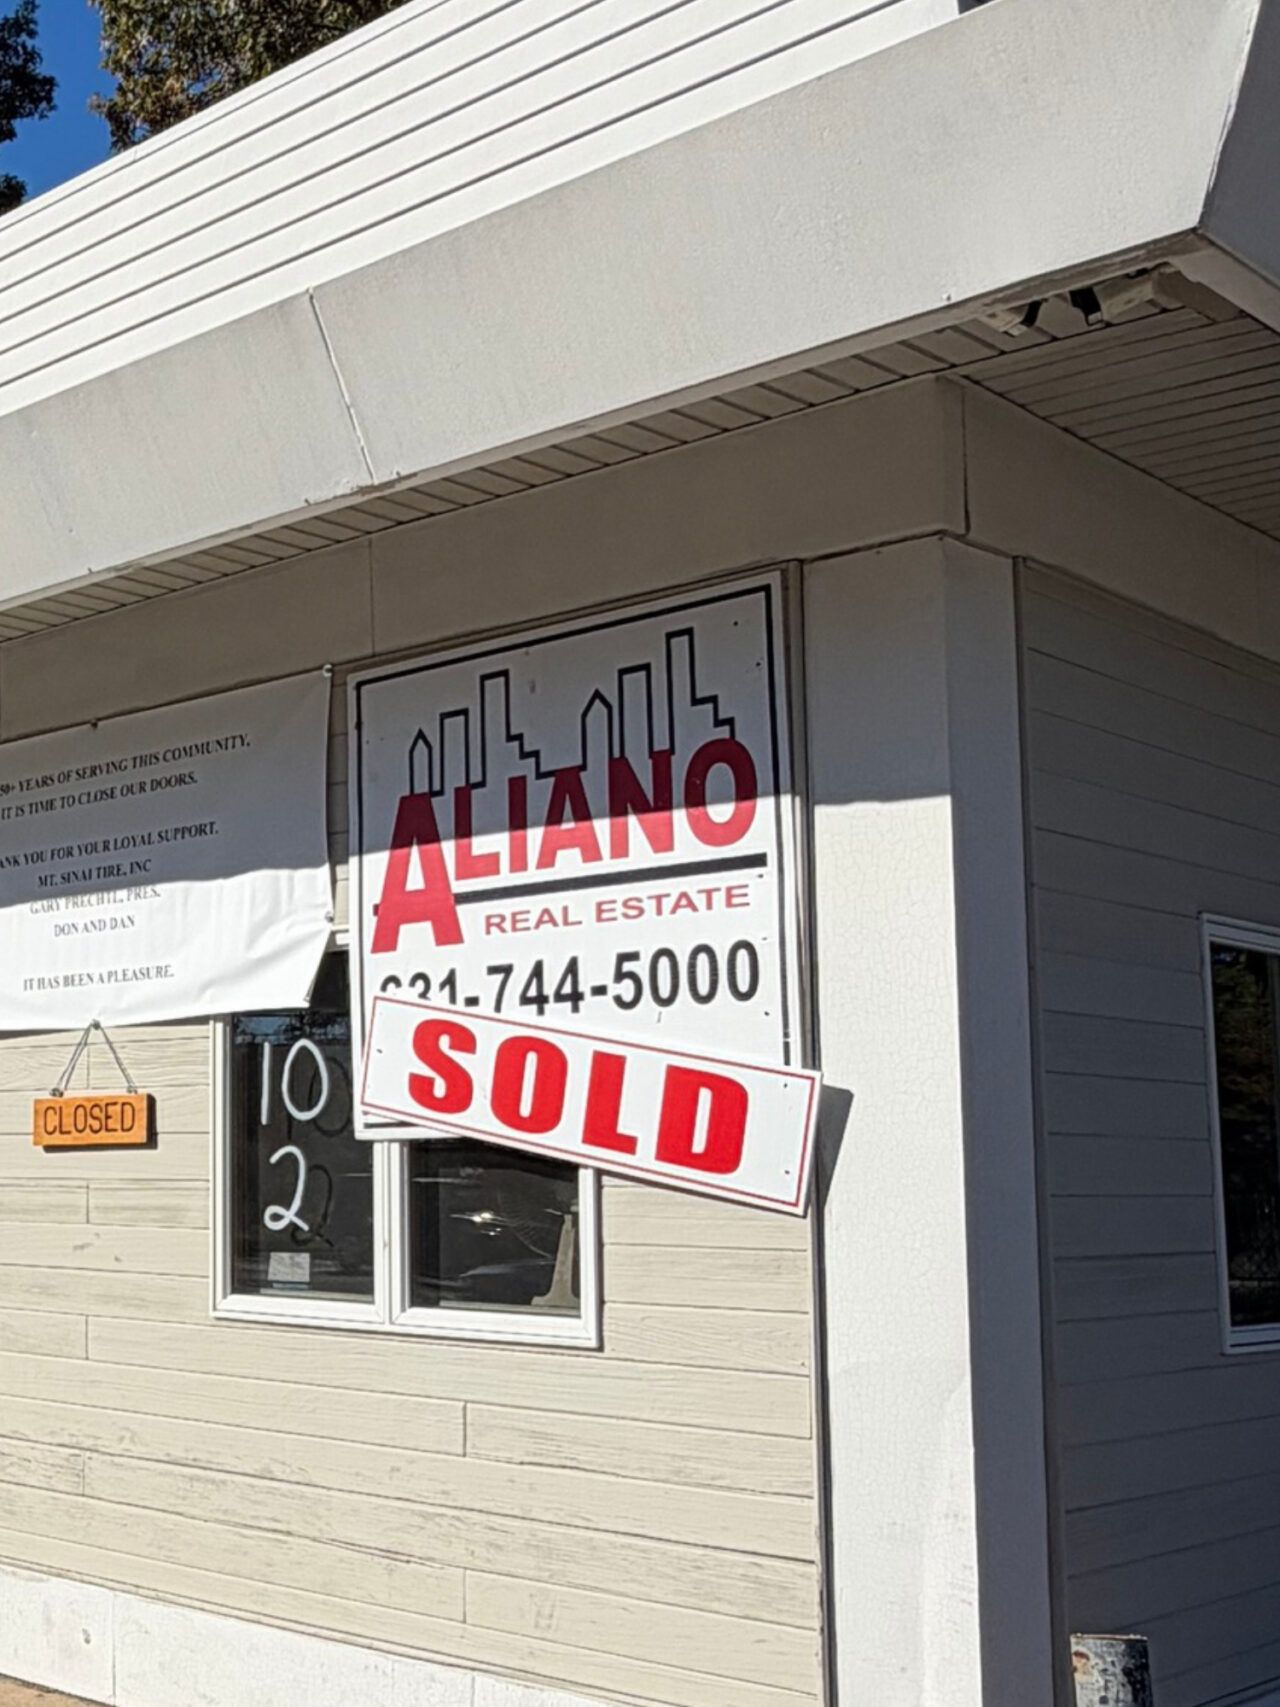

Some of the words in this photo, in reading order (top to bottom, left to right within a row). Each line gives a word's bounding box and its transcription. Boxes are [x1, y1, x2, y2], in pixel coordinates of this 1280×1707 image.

[0, 783, 16, 798] 50+
[18, 775, 55, 792] YEARS
[57, 770, 72, 784] OF
[75, 758, 128, 781] SERVING
[131, 752, 160, 769] THIS
[1, 807, 13, 820] IT
[15, 804, 25, 817] IS
[29, 799, 56, 815] TIME
[60, 795, 76, 809] TO
[77, 786, 117, 805] CLOSE
[121, 781, 147, 797] OUR
[150, 771, 198, 792] DOORS.
[23, 850, 48, 865] YOU
[50, 846, 75, 860] FOR
[77, 839, 111, 856] YOUR
[113, 832, 155, 850] LOYAL
[157, 821, 219, 843] SUPPORT.
[370, 738, 758, 953] ALIANO
[38, 874, 58, 887] MT.
[60, 868, 92, 884] SINAI
[130, 859, 152, 874] INC
[30, 897, 61, 914] GARY
[127, 885, 161, 902] PRES.
[484, 904, 584, 936] REAL
[595, 885, 751, 922] ESTATE
[54, 922, 79, 937] DON
[81, 918, 107, 934] AND
[110, 915, 136, 931] DAN
[23, 978, 35, 992] IT
[37, 976, 60, 990] HAS
[63, 973, 94, 988] BEEN
[97, 973, 105, 985] A
[107, 965, 174, 984] PLEASURE.
[261, 1038, 329, 1125] 10
[408, 1018, 748, 1175] SOLD
[43, 1101, 136, 1136] CLOSED
[263, 1145, 309, 1231] 2
